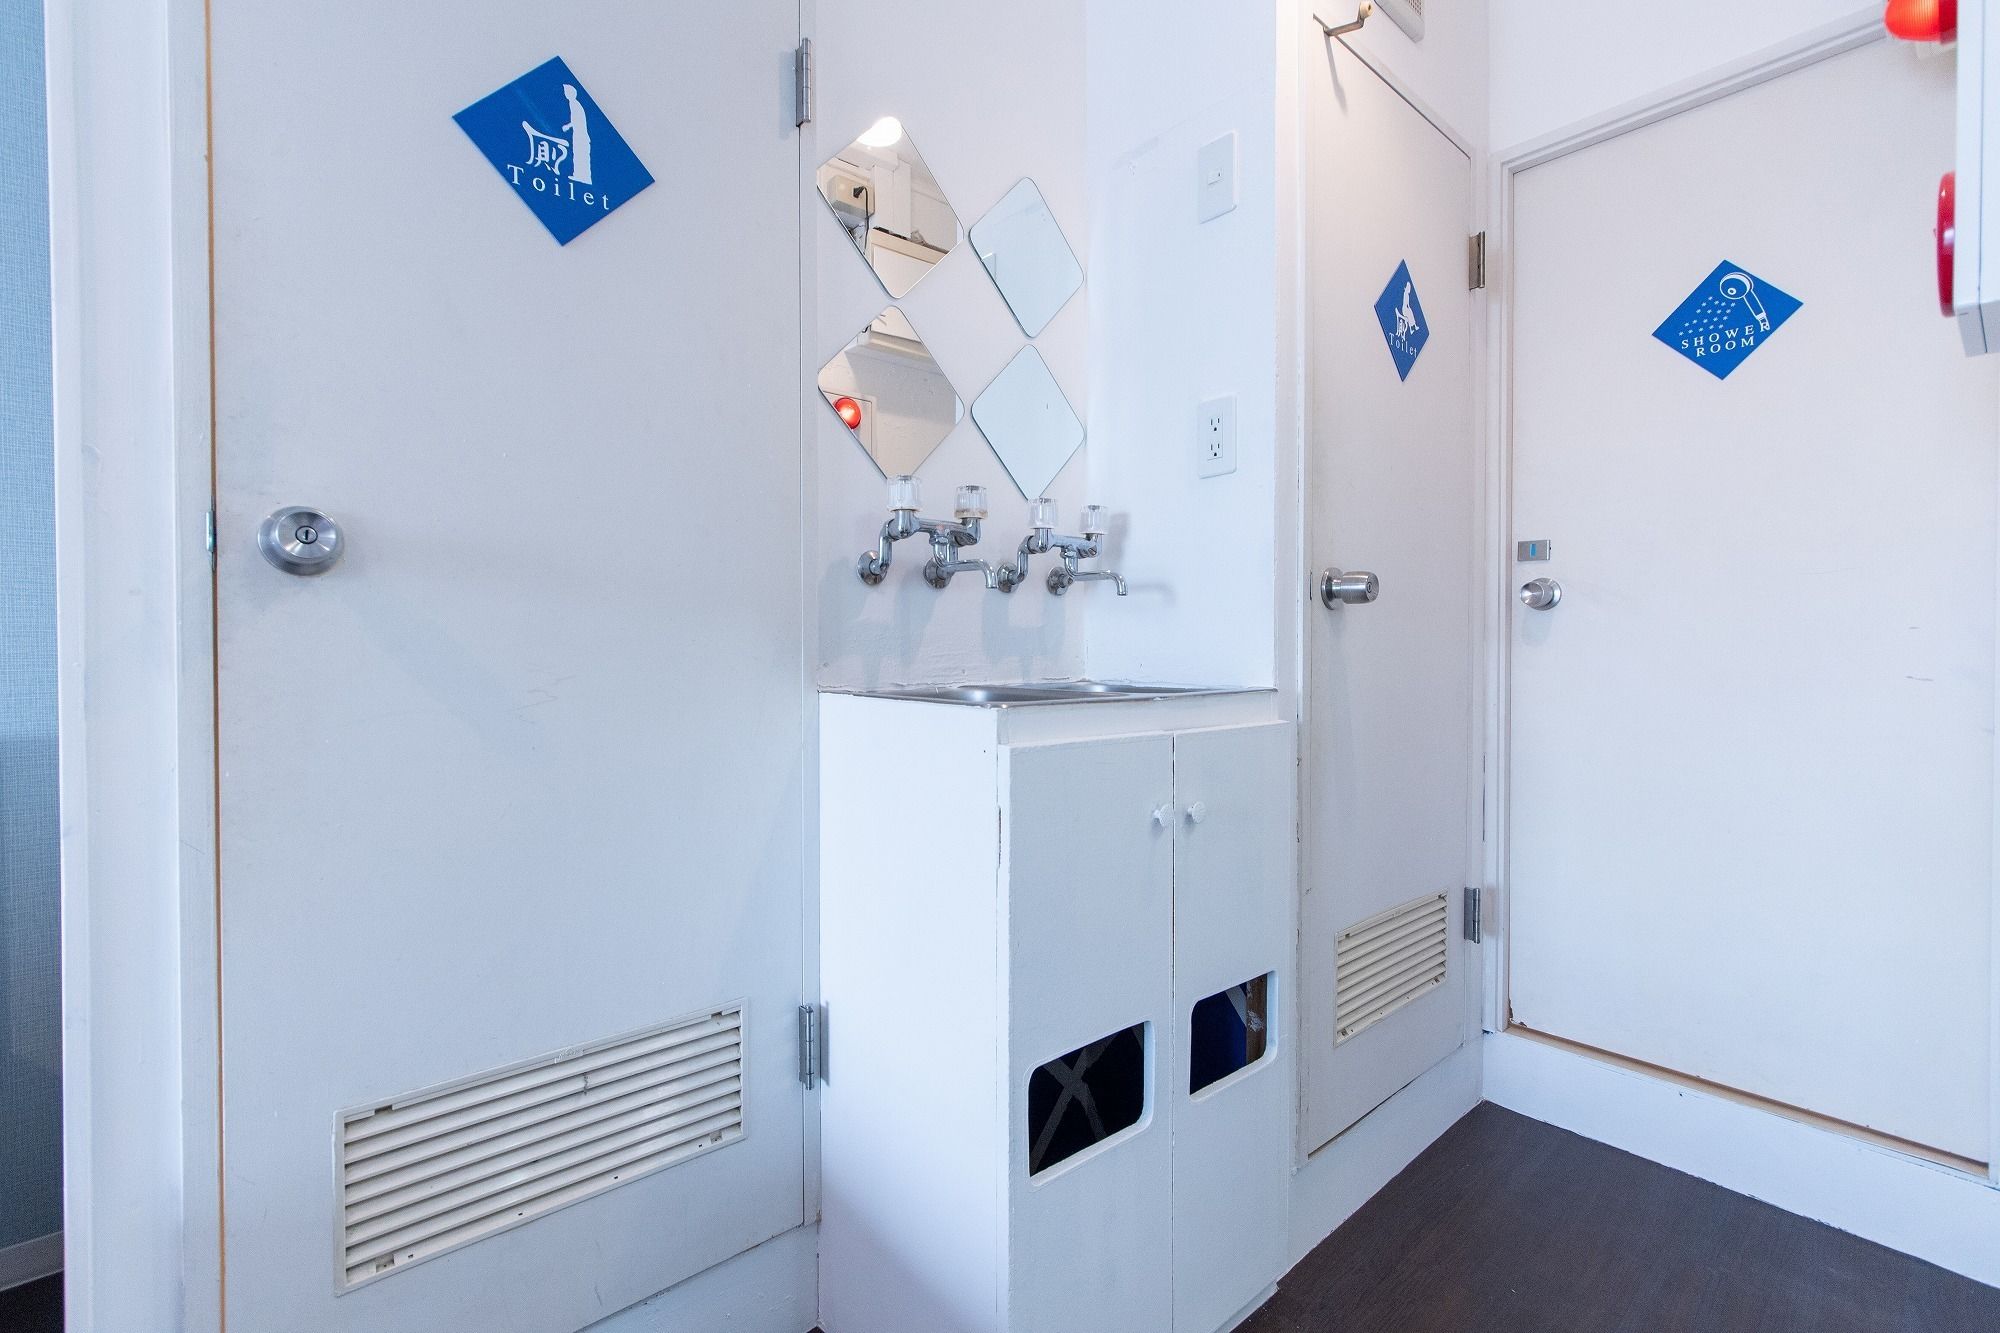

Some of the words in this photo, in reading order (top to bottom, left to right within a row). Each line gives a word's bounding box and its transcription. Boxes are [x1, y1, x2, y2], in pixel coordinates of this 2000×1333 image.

[507, 164, 610, 210] Toilet
[1389, 332, 1418, 358] Toilet
[1681, 323, 1770, 349] SHOWER
[1696, 336, 1755, 358] ROOM
